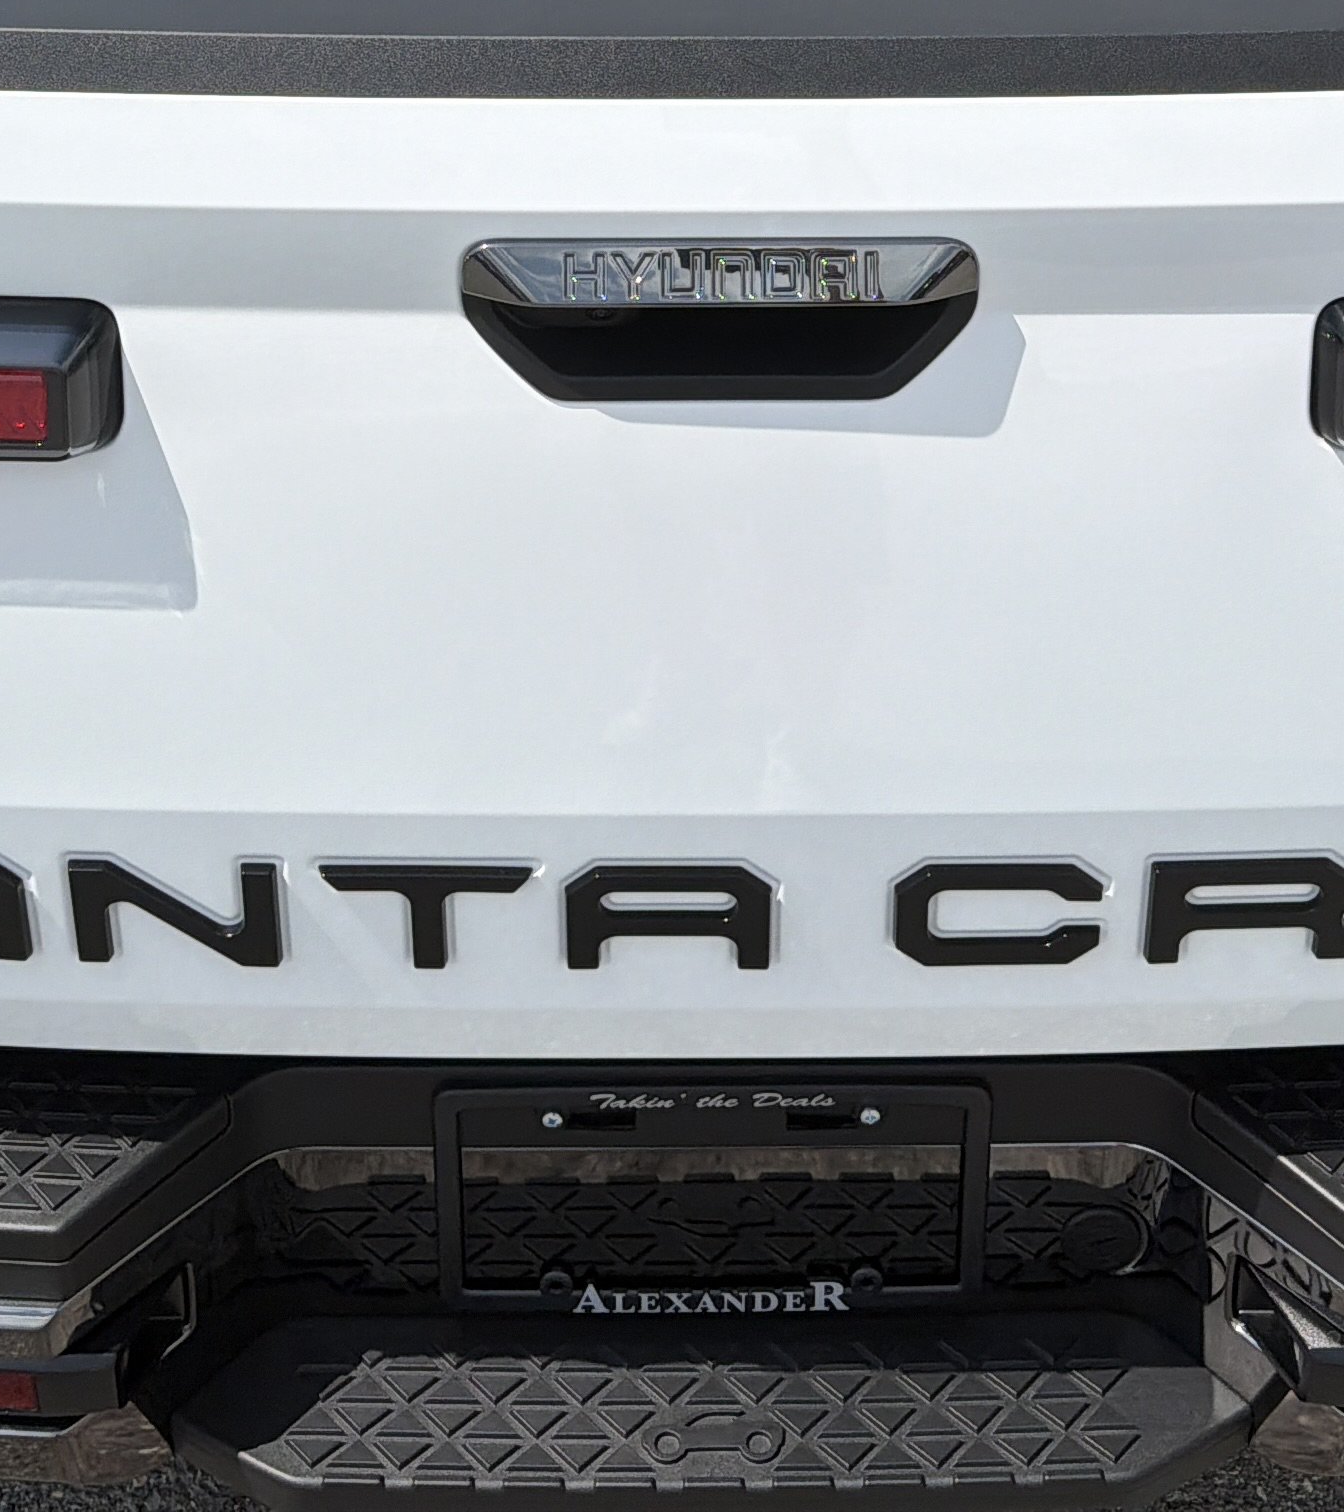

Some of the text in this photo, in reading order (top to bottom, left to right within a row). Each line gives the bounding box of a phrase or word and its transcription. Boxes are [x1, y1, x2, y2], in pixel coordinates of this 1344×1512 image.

[562, 248, 882, 302] HYUNDAI
[589, 1092, 837, 1111] Takin' the Deals
[573, 1280, 850, 1315] ALEXANDER
